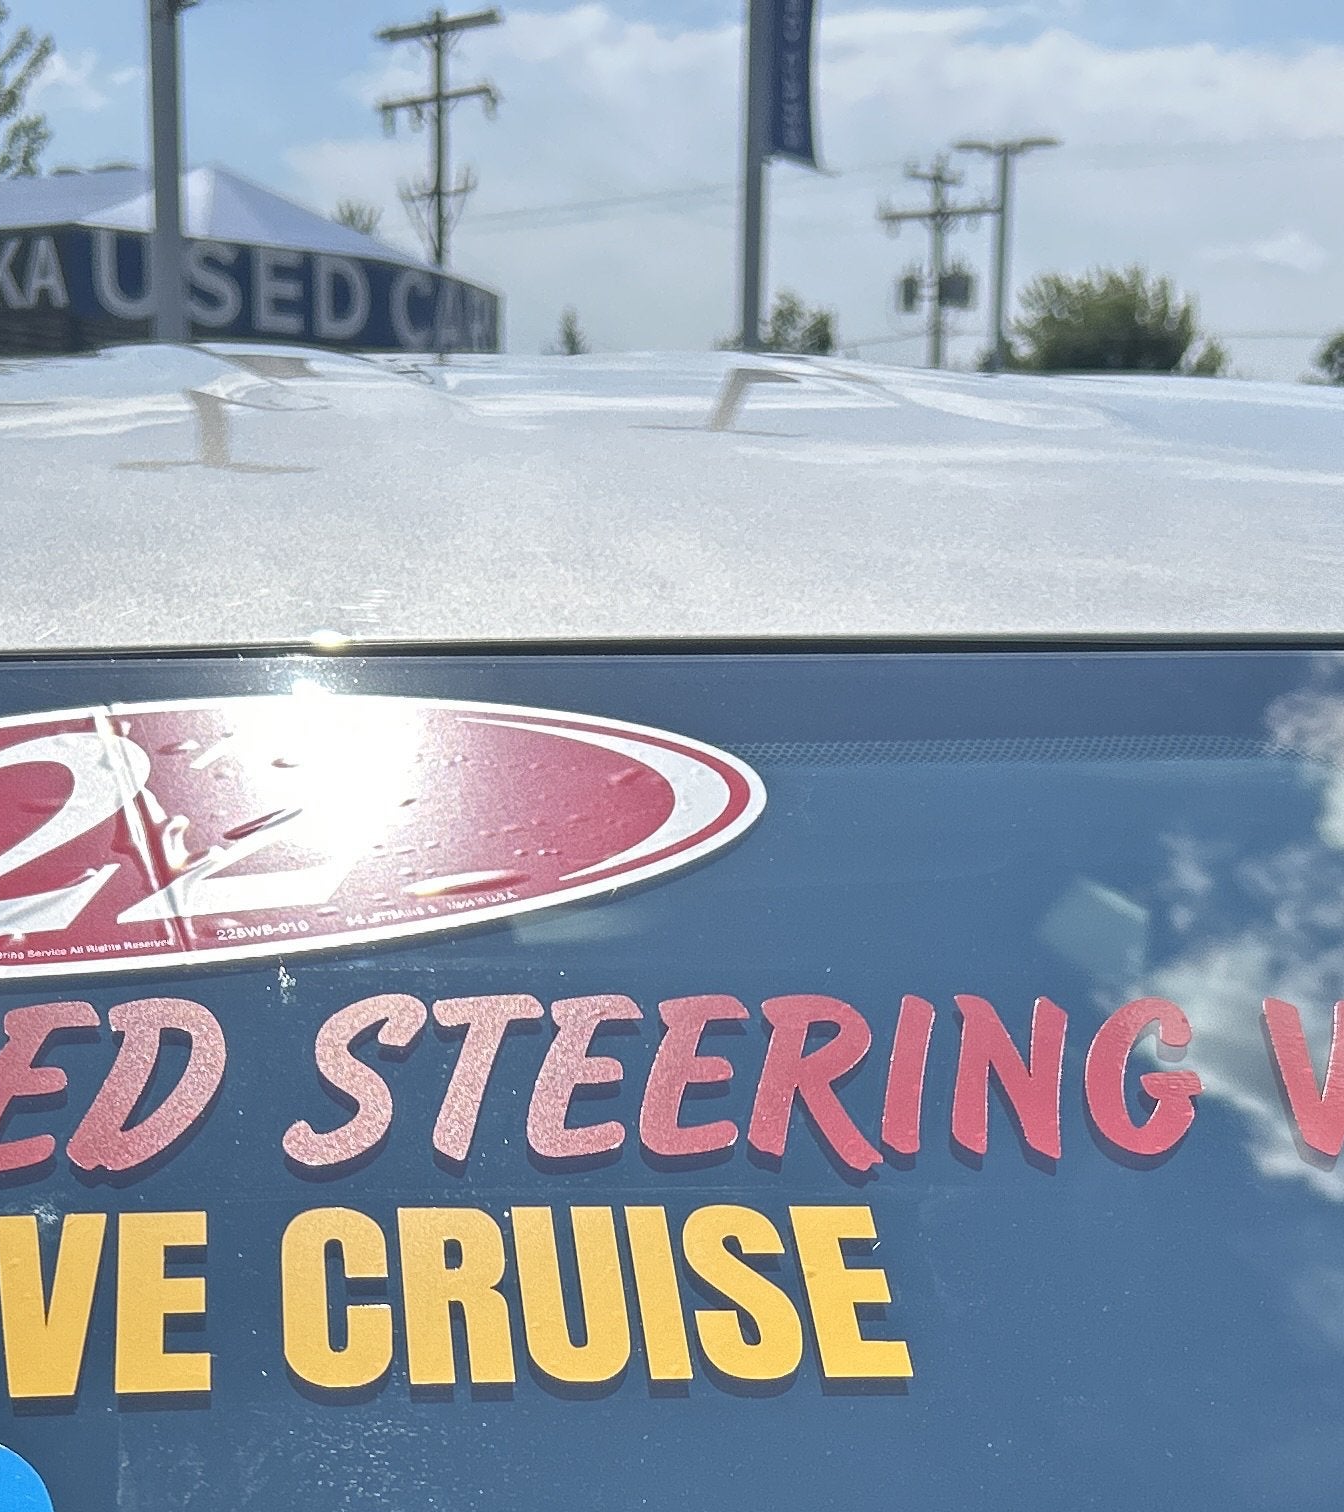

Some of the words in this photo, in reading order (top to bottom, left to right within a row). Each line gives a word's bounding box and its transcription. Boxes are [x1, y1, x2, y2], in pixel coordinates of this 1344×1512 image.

[90, 227, 372, 341] USED
[281, 994, 1205, 1171] STEERING
[281, 1204, 914, 1388] CRUISE
